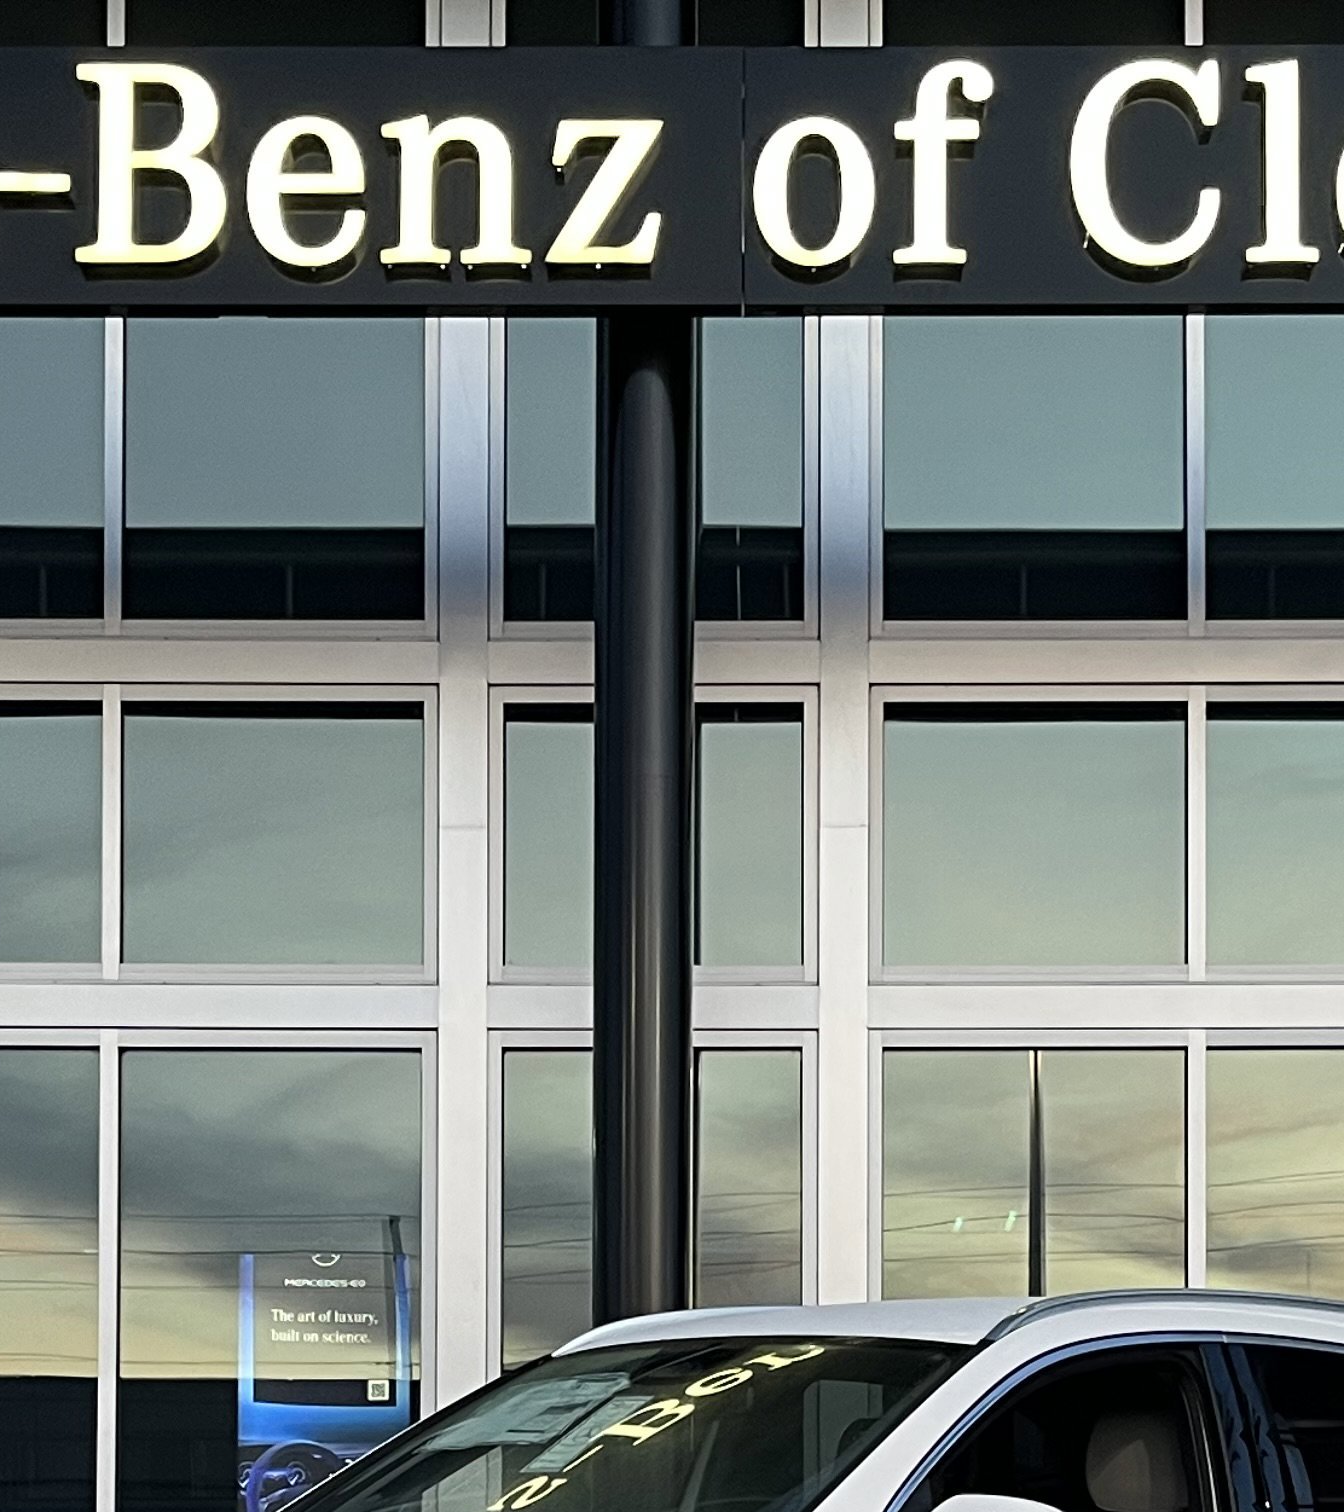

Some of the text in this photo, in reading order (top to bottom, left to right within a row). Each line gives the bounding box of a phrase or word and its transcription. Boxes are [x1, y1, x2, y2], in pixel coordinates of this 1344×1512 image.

[752, 59, 995, 267] of
[271, 1308, 379, 1327] The art of luxury,
[271, 1328, 371, 1344] built on science.
